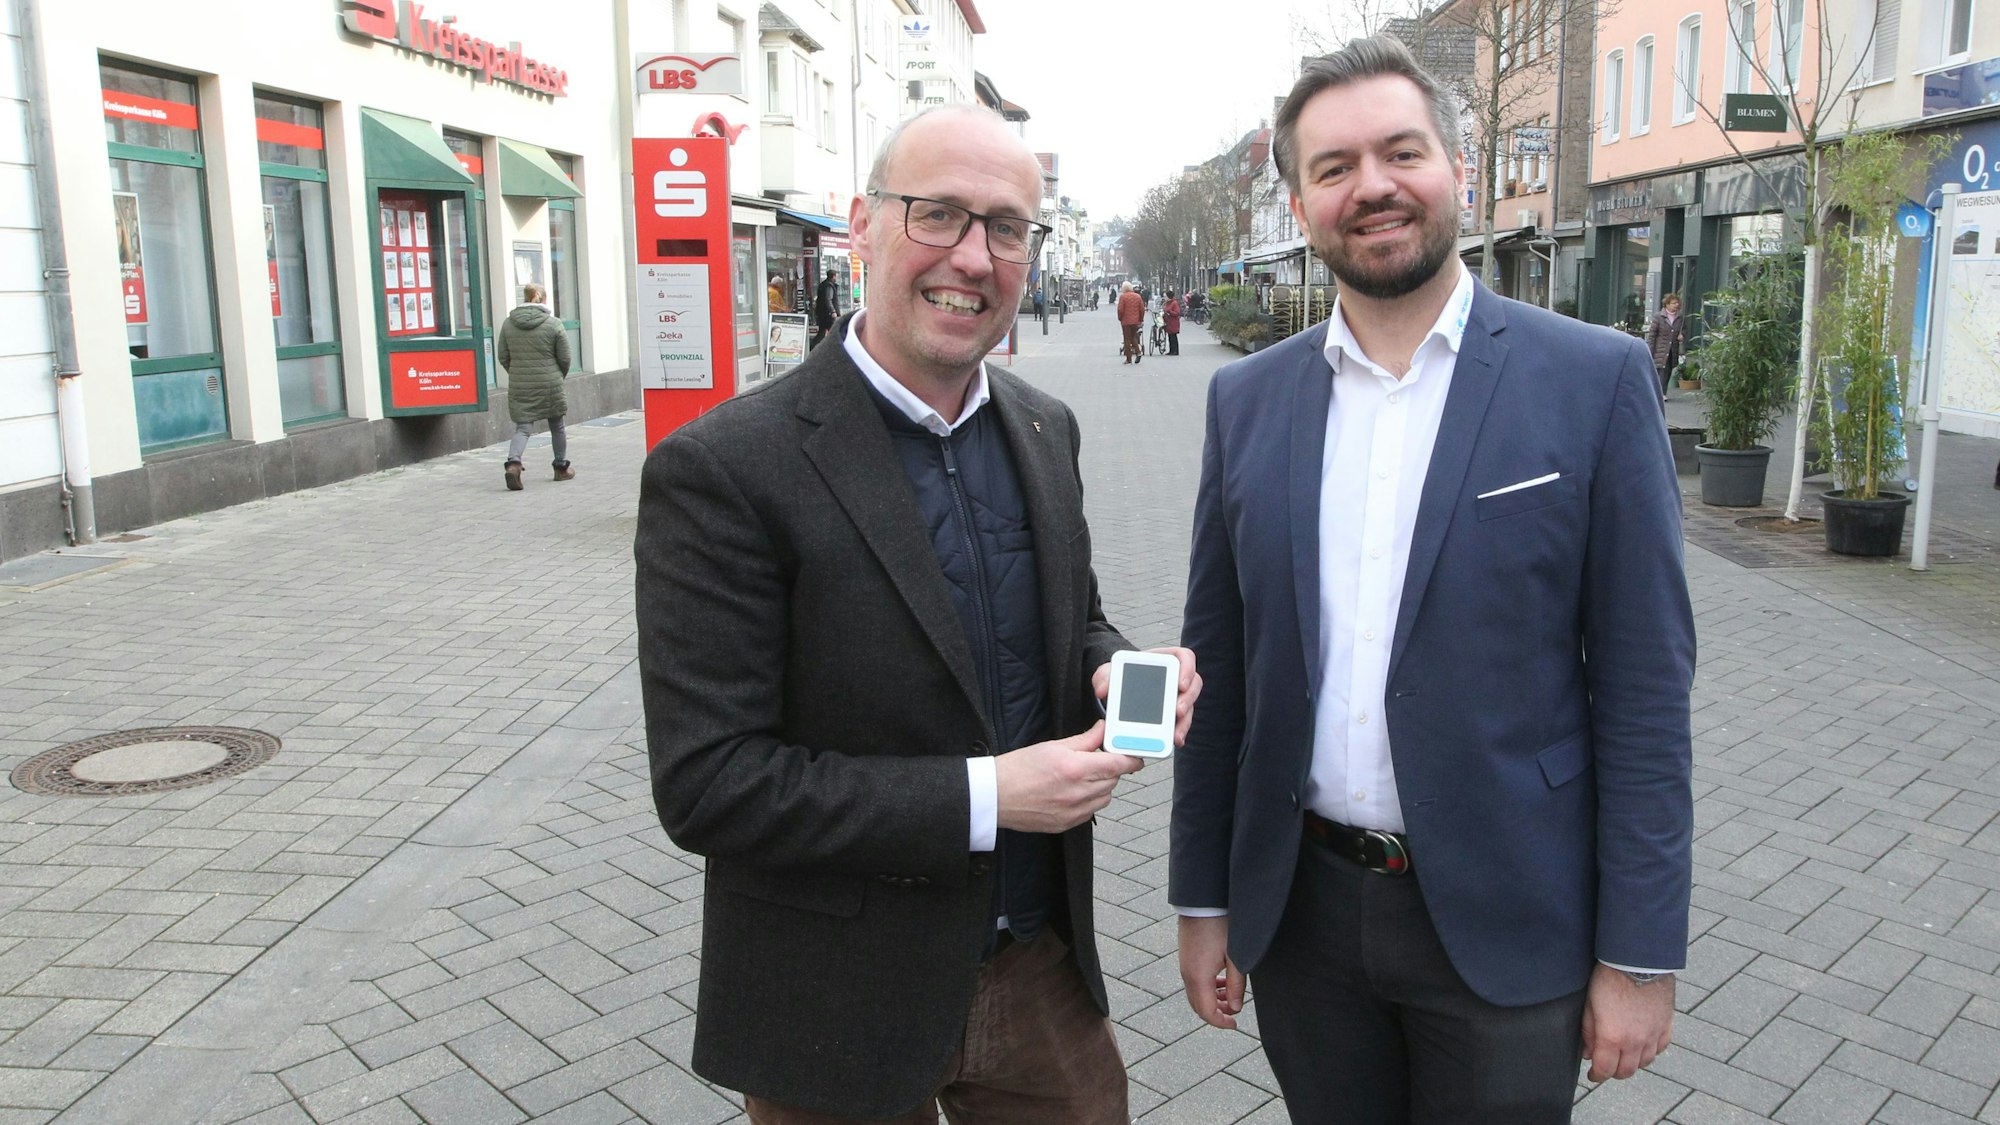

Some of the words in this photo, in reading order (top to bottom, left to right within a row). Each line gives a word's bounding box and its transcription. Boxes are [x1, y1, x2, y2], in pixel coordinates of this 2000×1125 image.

[408, 0, 568, 97] Kreissparkasse
[906, 61, 936, 70] SPORT
[649, 69, 697, 89] LBS
[1737, 107, 1777, 118] BLUMEN
[659, 314, 677, 323] LBS
[659, 331, 683, 340] Deka
[660, 353, 705, 361] PROVINZIAL
[418, 370, 461, 378] Kreissparkasse
